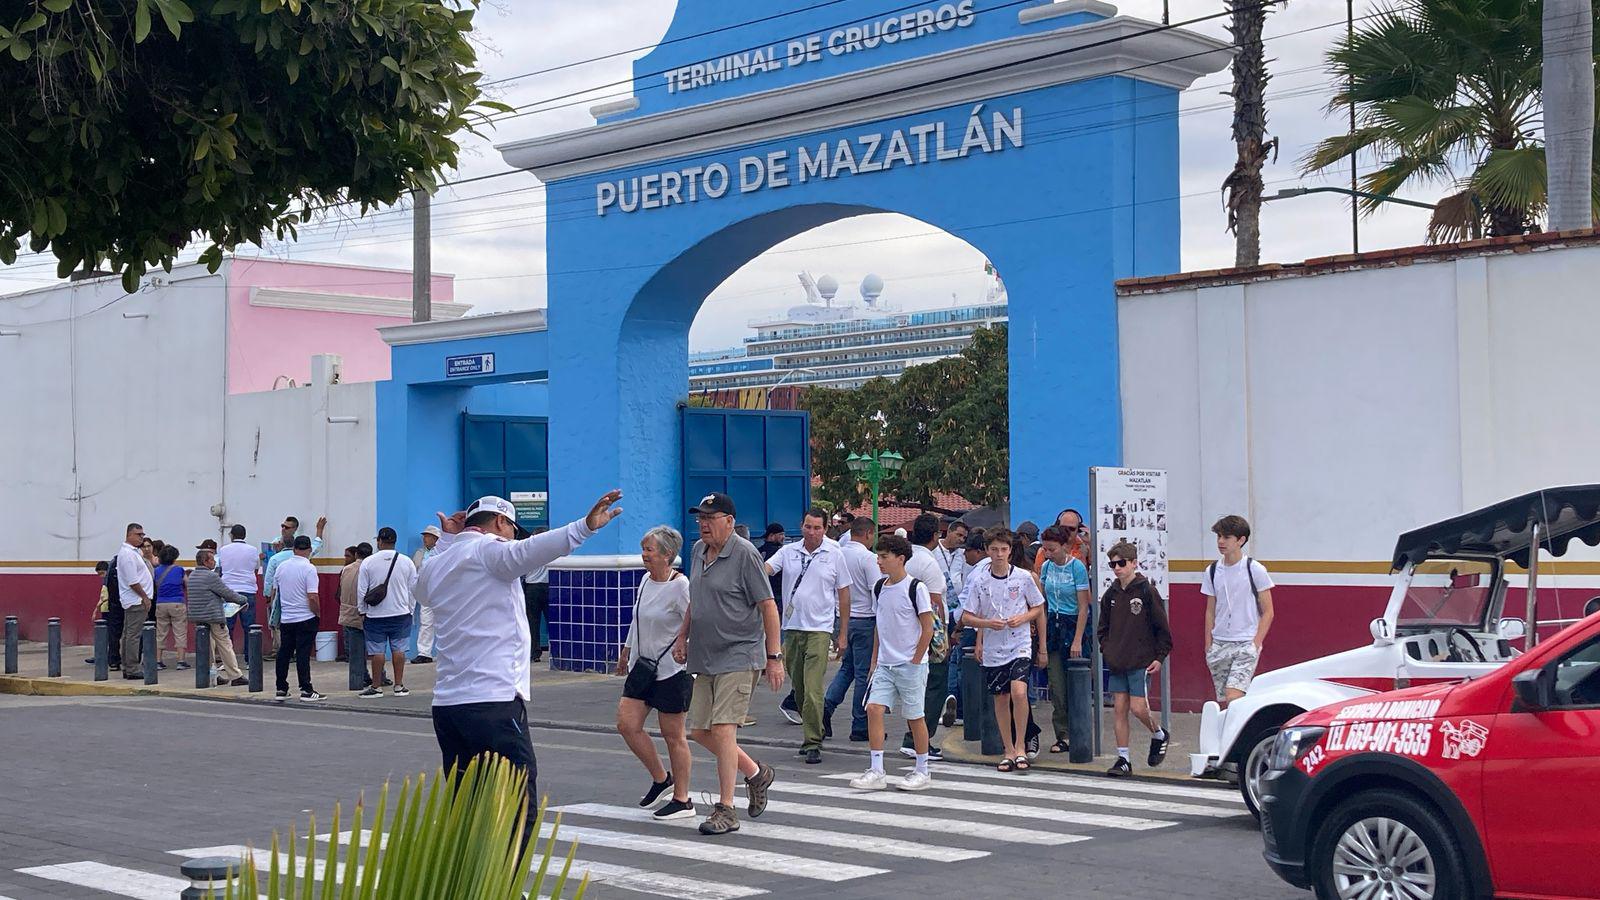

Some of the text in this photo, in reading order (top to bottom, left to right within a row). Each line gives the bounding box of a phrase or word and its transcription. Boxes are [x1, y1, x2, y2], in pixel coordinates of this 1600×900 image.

[664, 0, 976, 94] TERMINAL DE CRUCEROS
[596, 104, 1023, 216] PUERTO DE MAZATLÁN
[1335, 698, 1441, 720] SERVICIO A DOMICILIO
[1345, 720, 1434, 757] 669-981-3535
[1302, 745, 1326, 773] 242
